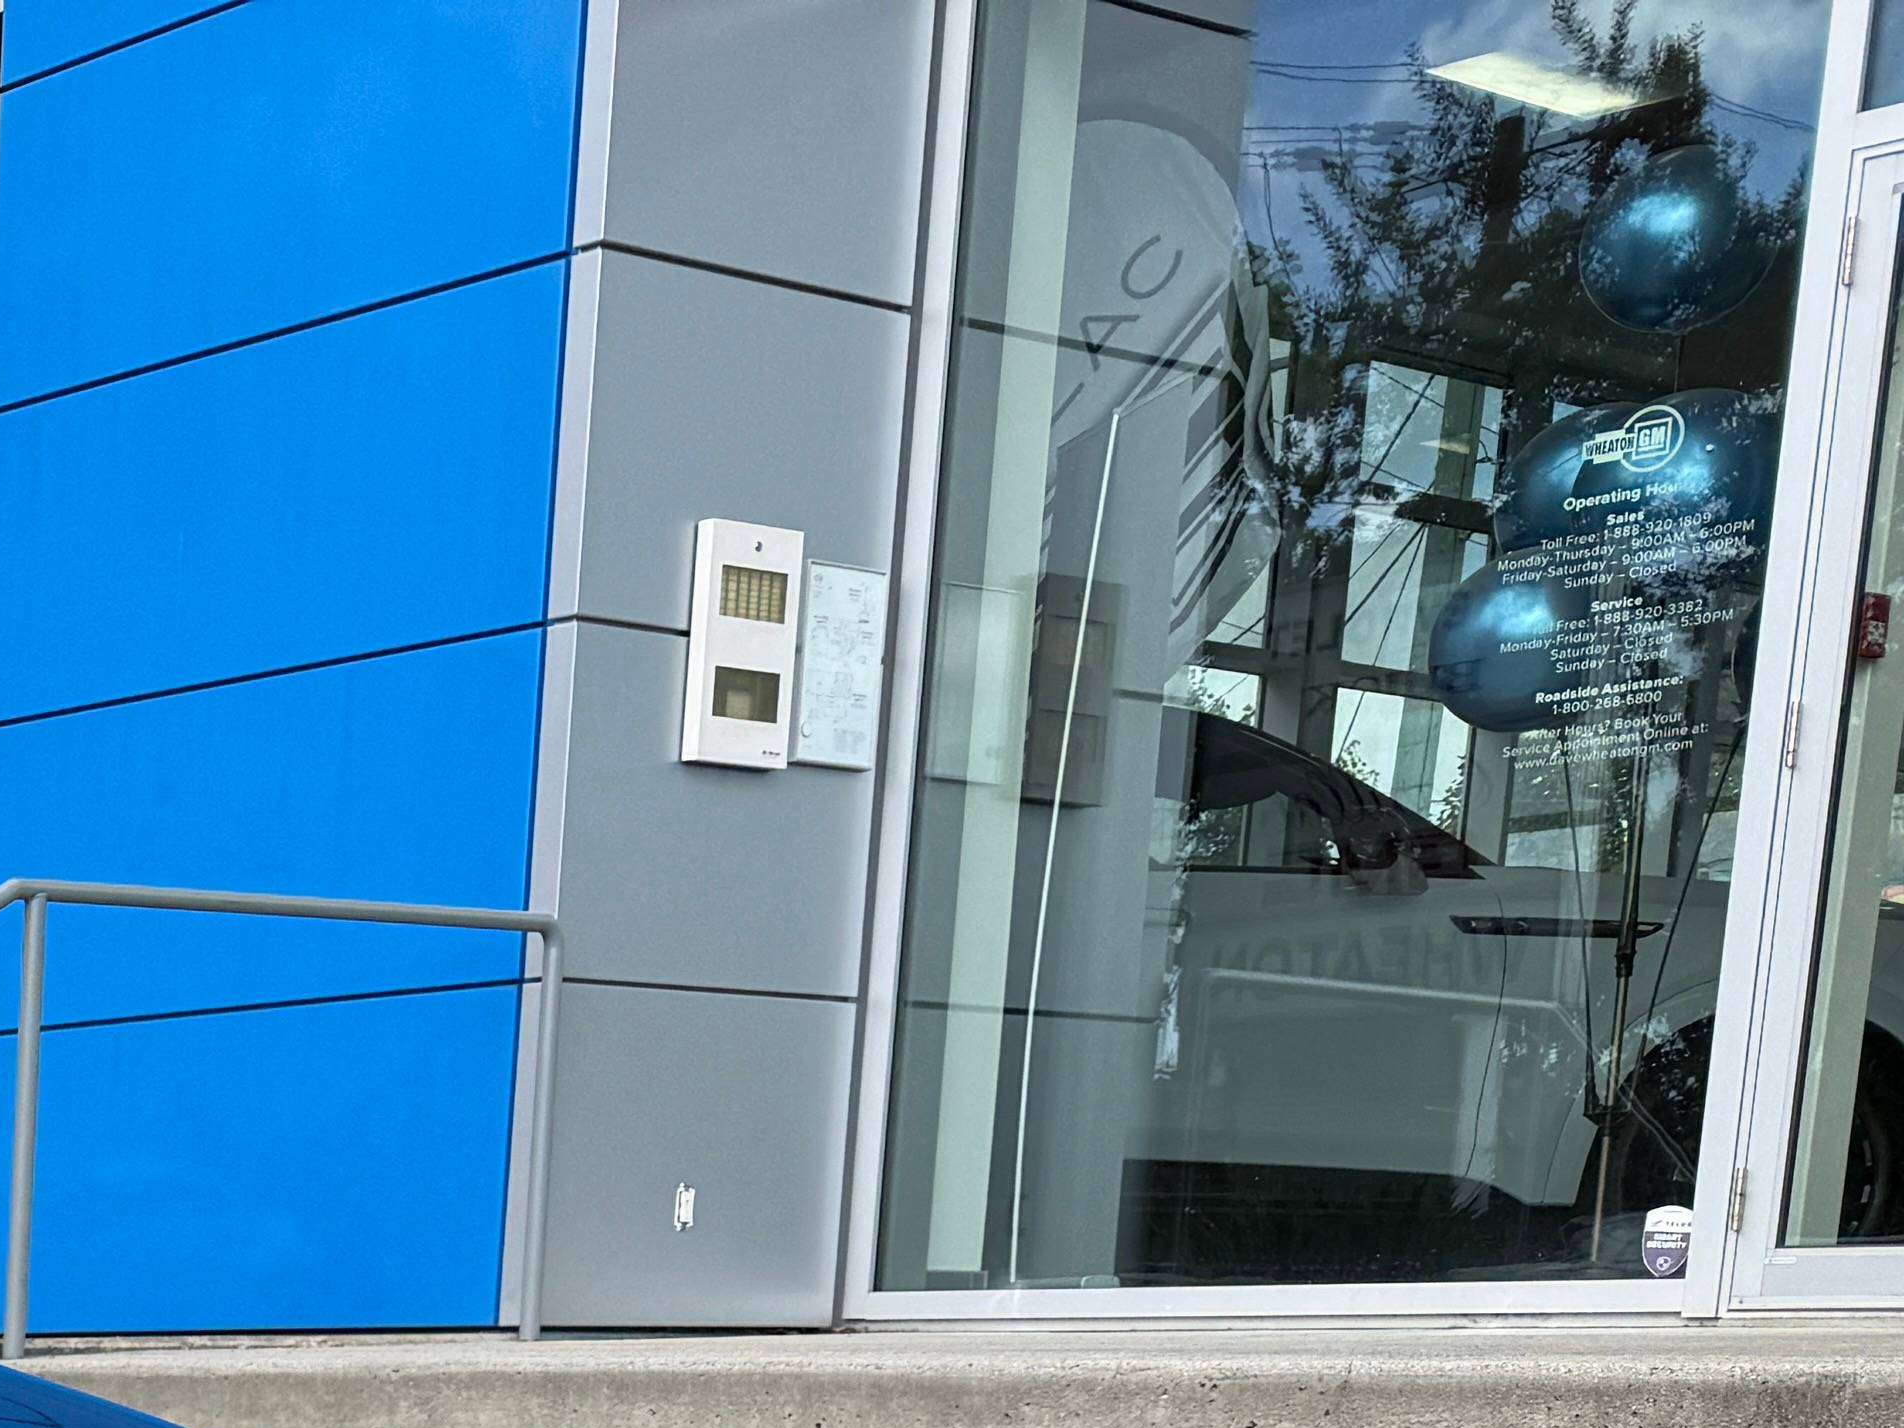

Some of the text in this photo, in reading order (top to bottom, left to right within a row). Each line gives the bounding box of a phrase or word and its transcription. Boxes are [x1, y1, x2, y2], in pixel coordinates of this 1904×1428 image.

[1585, 425, 1666, 457] WHEATON GM
[1563, 481, 1682, 511] Operating Hour
[1540, 512, 1712, 550] Toll Free: 1-888-920-1809
[1607, 511, 1645, 525] Sales
[1497, 544, 1615, 571] Monday-Thursday
[1631, 531, 1685, 549] 9:00AM
[1699, 519, 1755, 539] 6:00PM
[1502, 560, 1607, 584] Friday-Saturday
[1622, 546, 1676, 565] 9:00AM
[1564, 572, 1614, 588] Sunday
[1629, 560, 1677, 578] Closed
[1590, 596, 1643, 612] Service
[1500, 631, 1598, 654] Monday-Friday
[1613, 620, 1665, 637] 7:30AM
[1681, 608, 1733, 627] 5:30PM
[1556, 618, 1590, 632] Free:
[1550, 643, 1610, 660] Saturday
[1624, 632, 1672, 649] Closed
[1556, 658, 1605, 673] Sunday
[1620, 648, 1667, 664] Closed
[1535, 675, 1684, 704] Roadside Assistance:
[1552, 690, 1662, 715] 1-800-268-6800
[1614, 716, 1650, 729] Book
[1653, 712, 1682, 725] Your
[1503, 722, 1709, 758] Service Appointment Online at:
